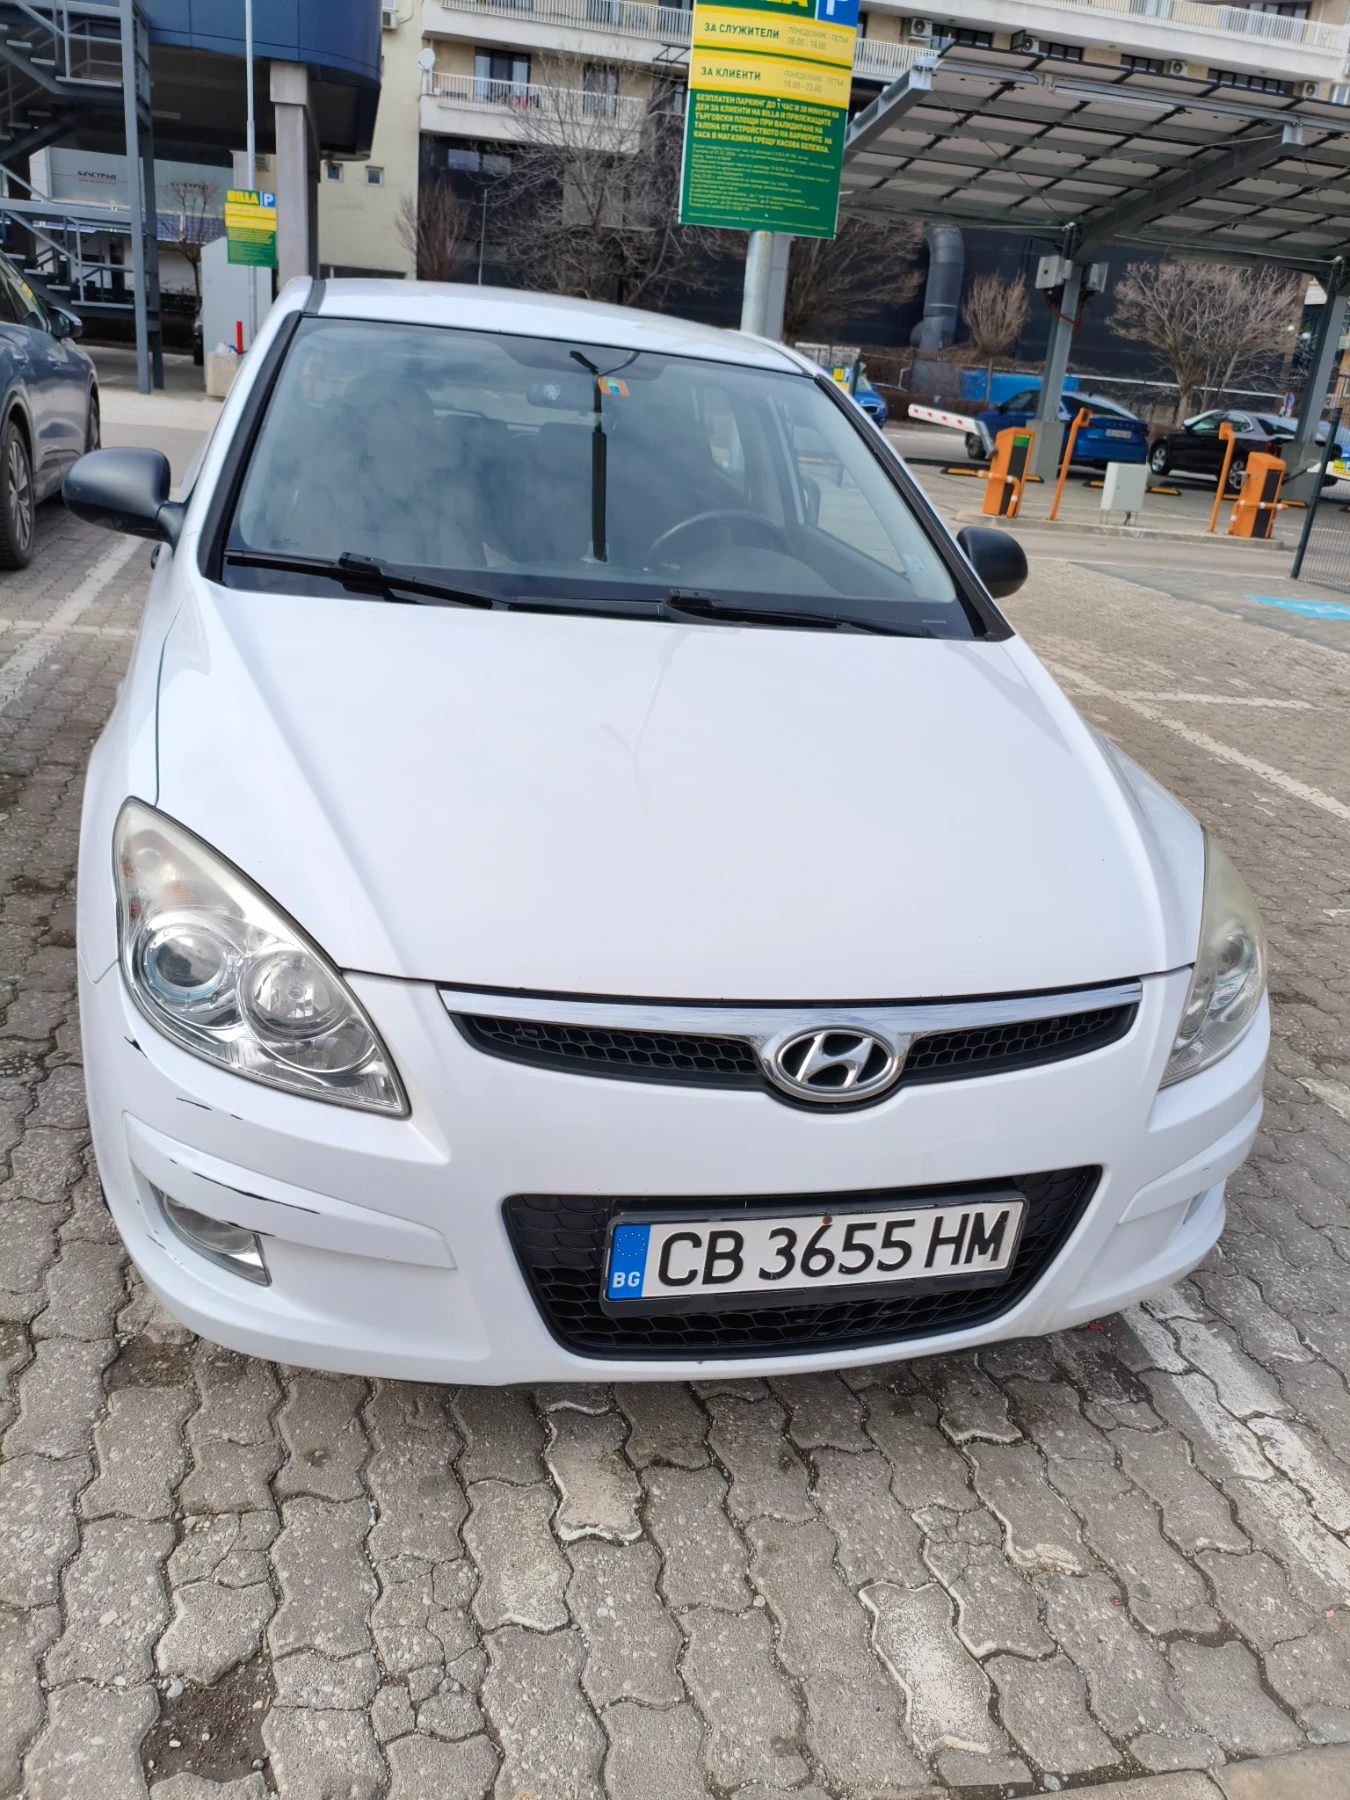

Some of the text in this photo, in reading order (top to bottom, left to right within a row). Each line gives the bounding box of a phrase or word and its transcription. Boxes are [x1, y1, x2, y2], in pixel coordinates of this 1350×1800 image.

[704, 23, 779, 39] ЗА СЛУЖИТЕЛИ
[788, 27, 826, 38] ПОНЕДЕЛНИК
[831, 35, 849, 43] ПЕТЪК
[701, 67, 760, 81] ЗА КЛИЕНТИ
[784, 70, 822, 81] ПОНЕДЕЛНИК
[826, 78, 844, 86] ПЕТЪК
[696, 93, 734, 103] БЕЗПЛАТЕН
[736, 97, 765, 106] ПАРКИНГ
[807, 107, 830, 116] МИНУТИ
[695, 103, 709, 111] ДЕН
[720, 105, 750, 114] КЛИЕНТИ
[786, 113, 832, 125] ПРИЛЕЖАЩИТЕ
[695, 112, 733, 122] ТЪРГОВСКИ
[734, 116, 758, 125] ПЛОЩИ
[774, 121, 814, 132] ВАЛИДИРАНЕ
[693, 130, 710, 138] КАСА
[718, 133, 752, 142] МАГАЗИНА
[752, 136, 776, 145] СРЕЩУ
[694, 121, 720, 129] ТАЛОНА
[730, 124, 778, 136] УСТРОЙСТВОТО
[789, 132, 823, 142] БАРИЕРИТЕ
[227, 190, 259, 205] BILLA
[658, 1210, 1010, 1287] CB 3655 HM
[612, 1271, 640, 1288] BG
